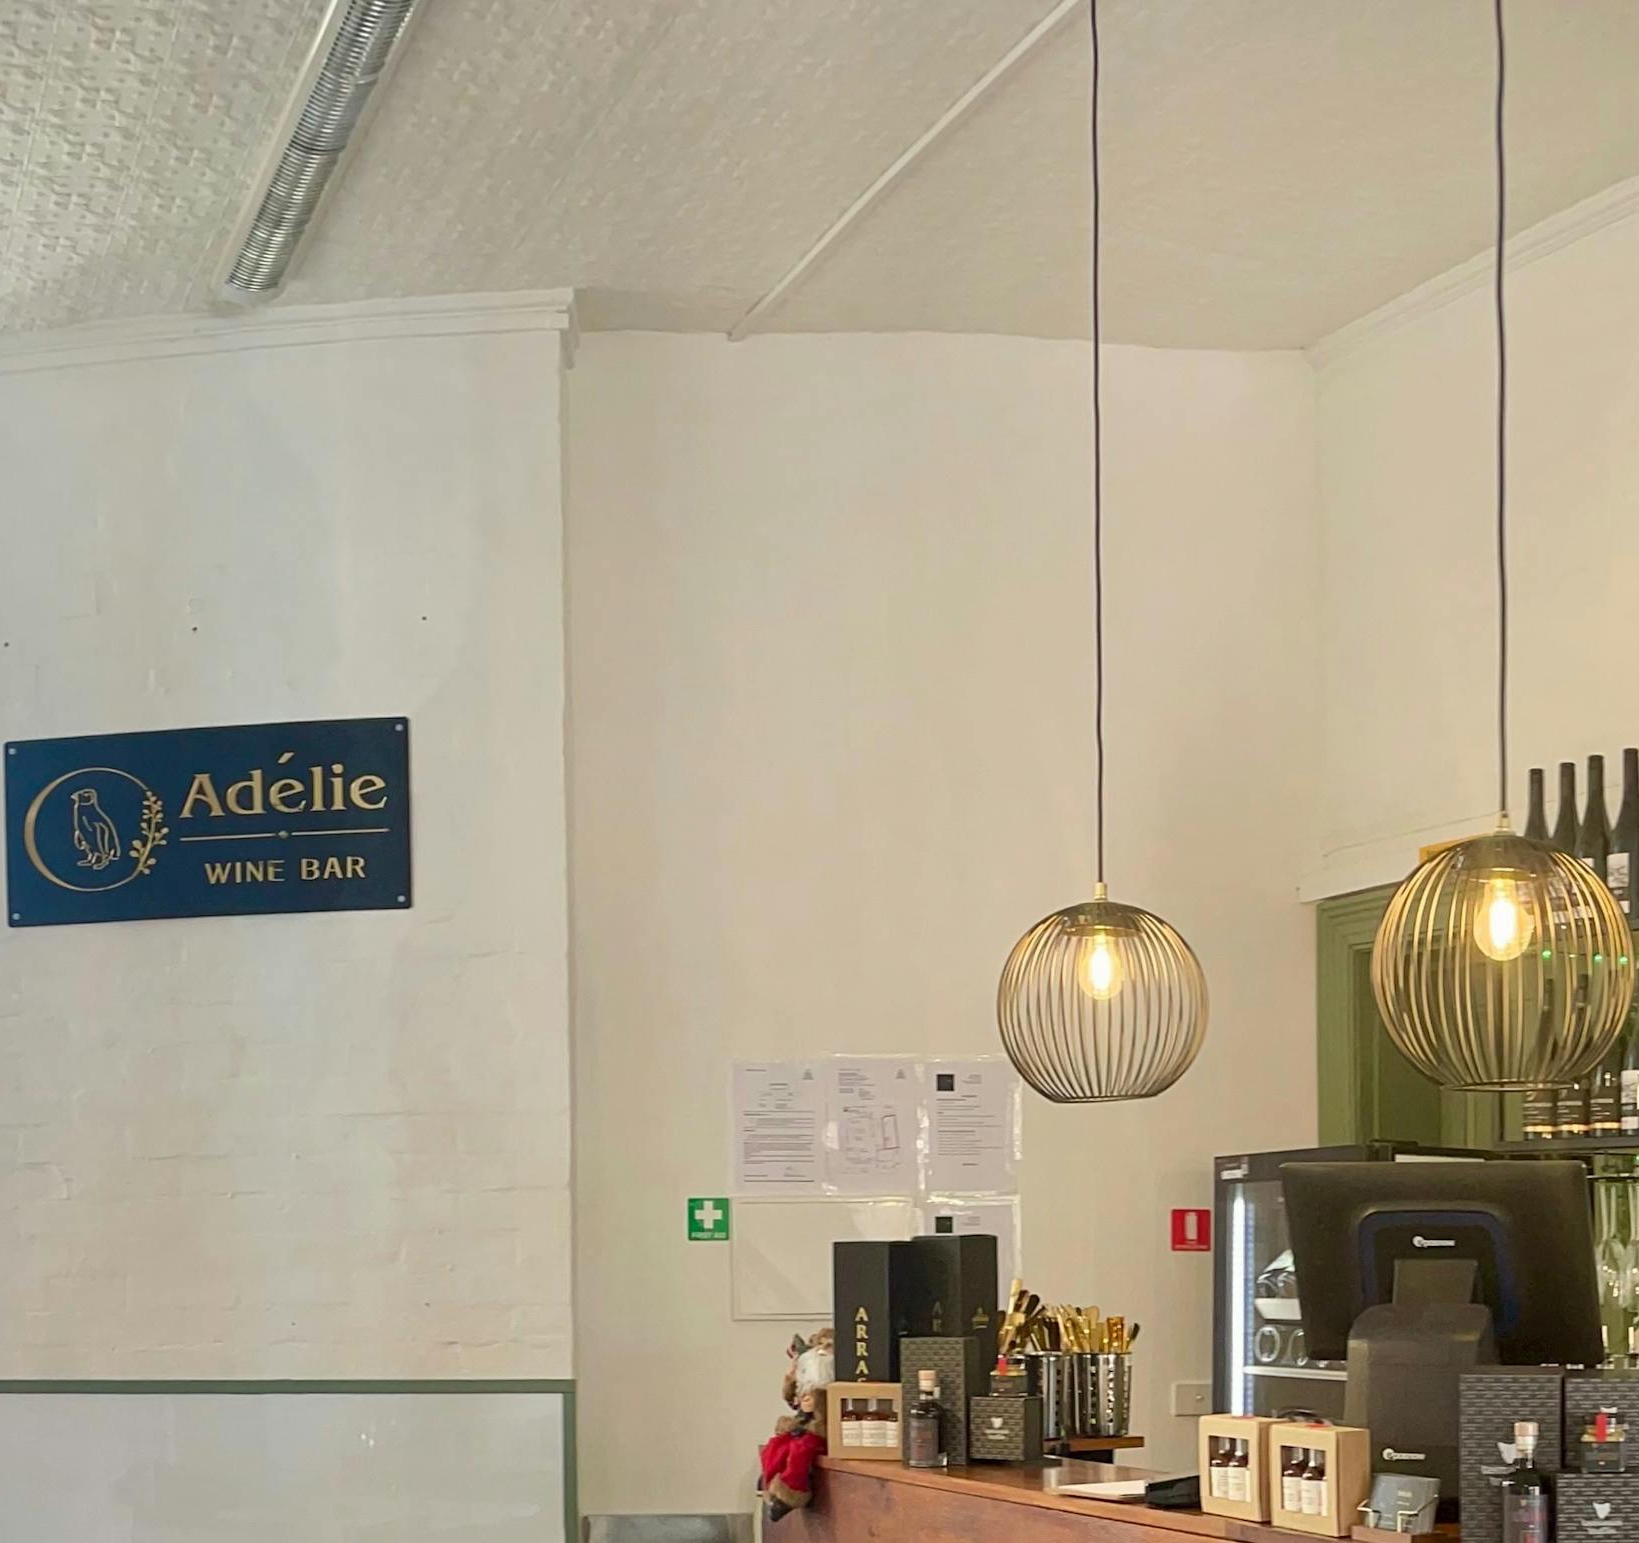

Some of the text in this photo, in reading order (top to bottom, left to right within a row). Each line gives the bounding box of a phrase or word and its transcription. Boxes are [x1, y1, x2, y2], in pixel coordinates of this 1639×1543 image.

[178, 751, 388, 819] Adélie
[204, 855, 367, 885] WINE BAR
[854, 1306, 869, 1382] ARRA
